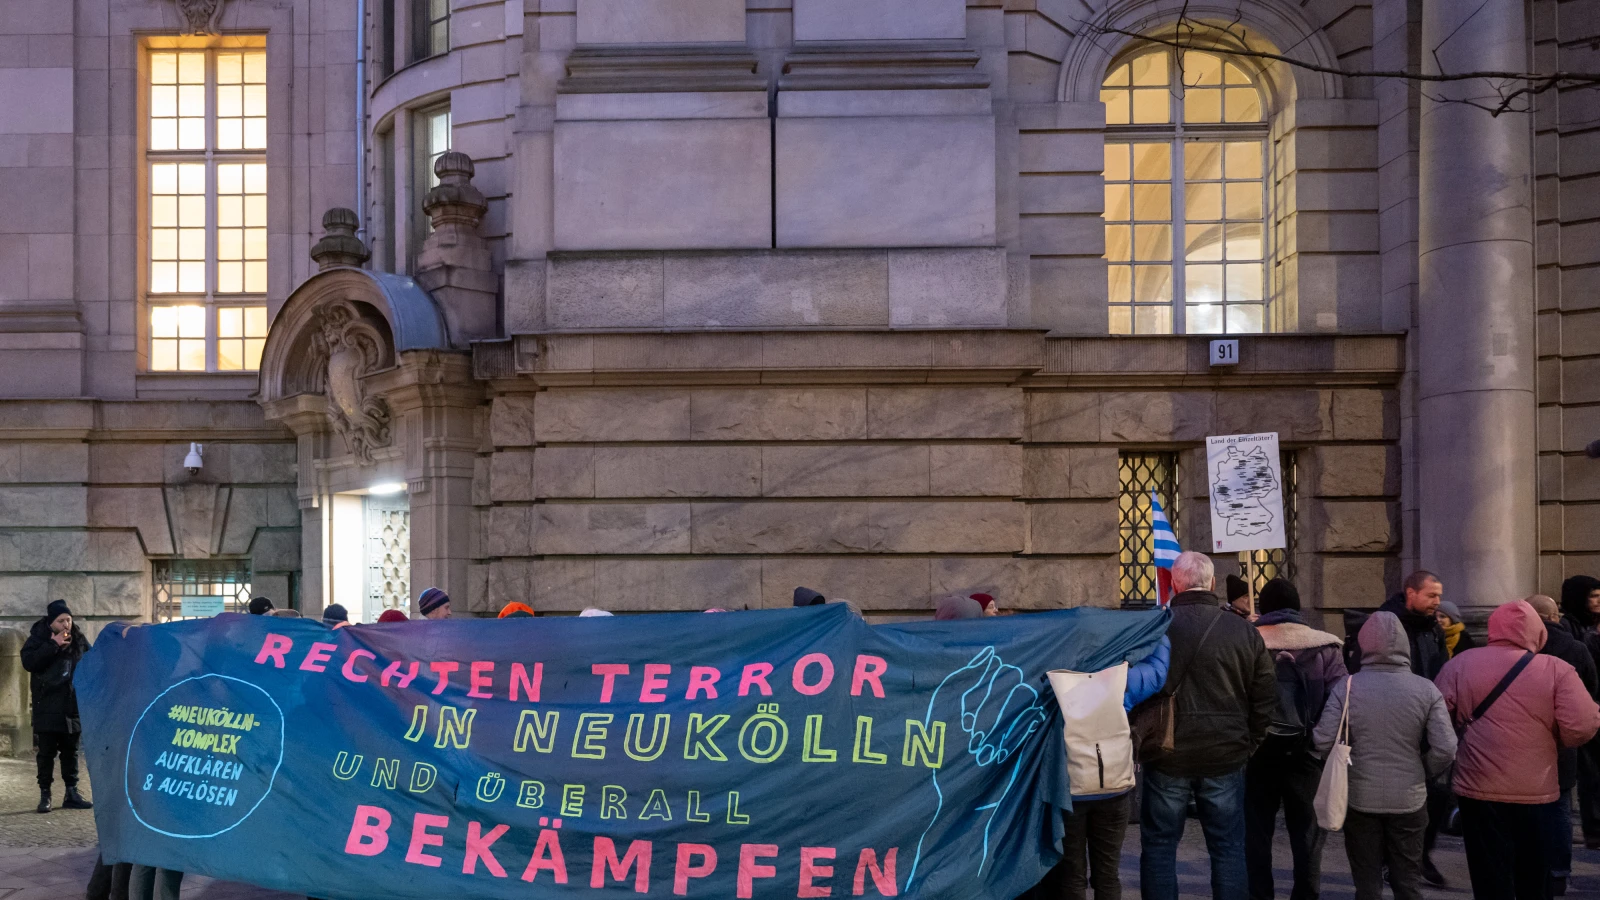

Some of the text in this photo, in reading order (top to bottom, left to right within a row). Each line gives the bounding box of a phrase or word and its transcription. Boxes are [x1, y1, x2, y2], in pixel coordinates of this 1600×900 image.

[1218, 343, 1232, 359] 91
[1238, 434, 1274, 443] Einzeltäter?
[254, 633, 887, 703] RECHTEN TERROR
[168, 704, 260, 731] #NEUKÖLLN-
[171, 728, 241, 754] KOMPLEX
[404, 703, 946, 769] IN NEUKÖLLN
[155, 751, 243, 780] AUFKLÄREN
[143, 773, 238, 807] & AUFLÖSEN
[332, 751, 750, 824] UND ÜBERALL
[344, 805, 899, 899] BEKÄMPFEN
